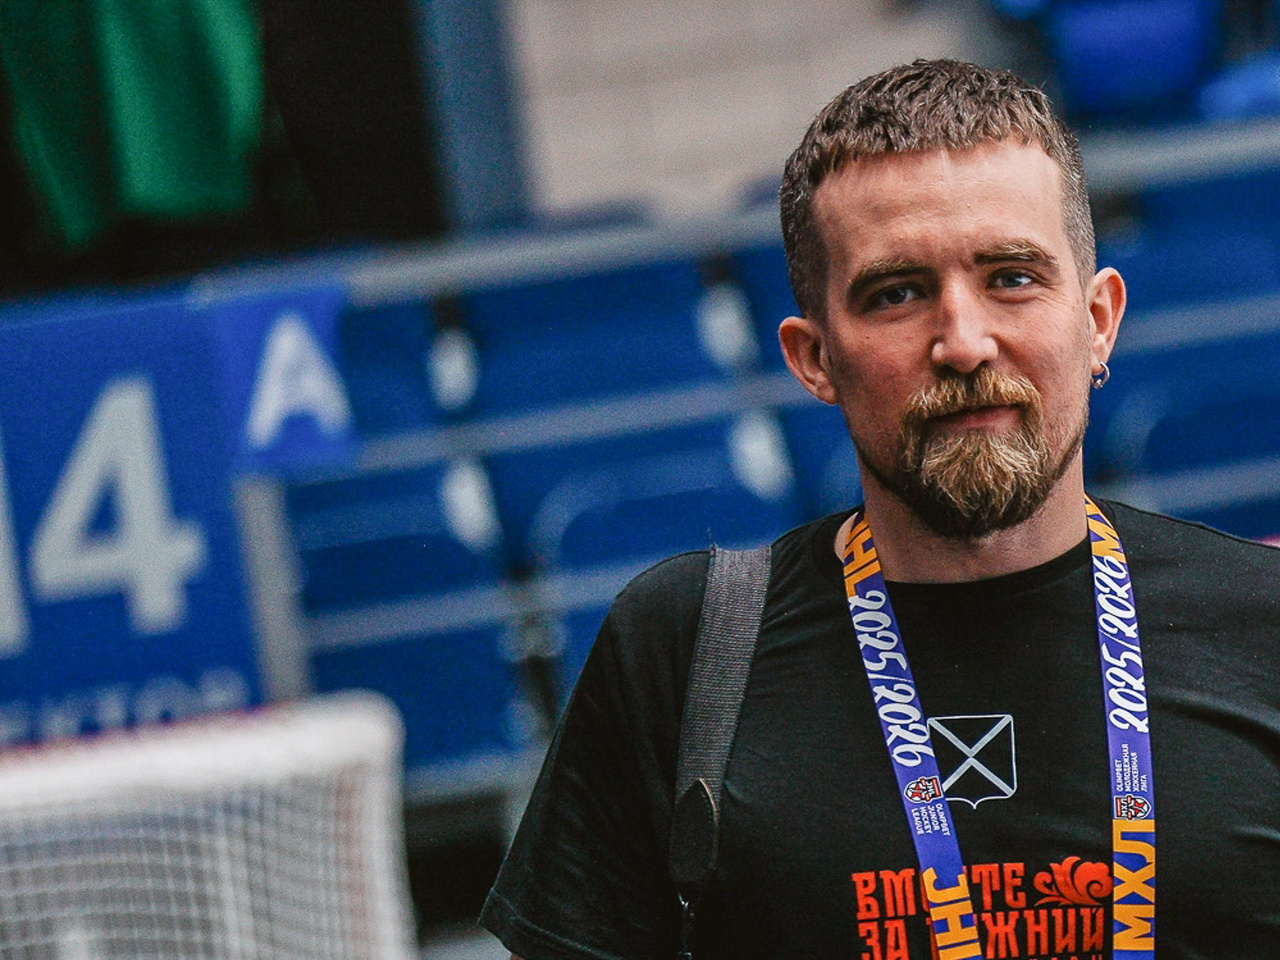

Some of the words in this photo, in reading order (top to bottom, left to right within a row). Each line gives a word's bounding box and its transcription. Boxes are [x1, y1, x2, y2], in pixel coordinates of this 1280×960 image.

[1092, 555, 1149, 733] 2025/2026
[848, 589, 935, 767] 2025/2026
[1140, 774, 1148, 792] ЛИГА
[911, 808, 925, 835] LEAGUE
[920, 806, 933, 834] HOCKEY
[852, 862, 1027, 920] ВМТЕ
[1113, 819, 1155, 950] МХЛ
